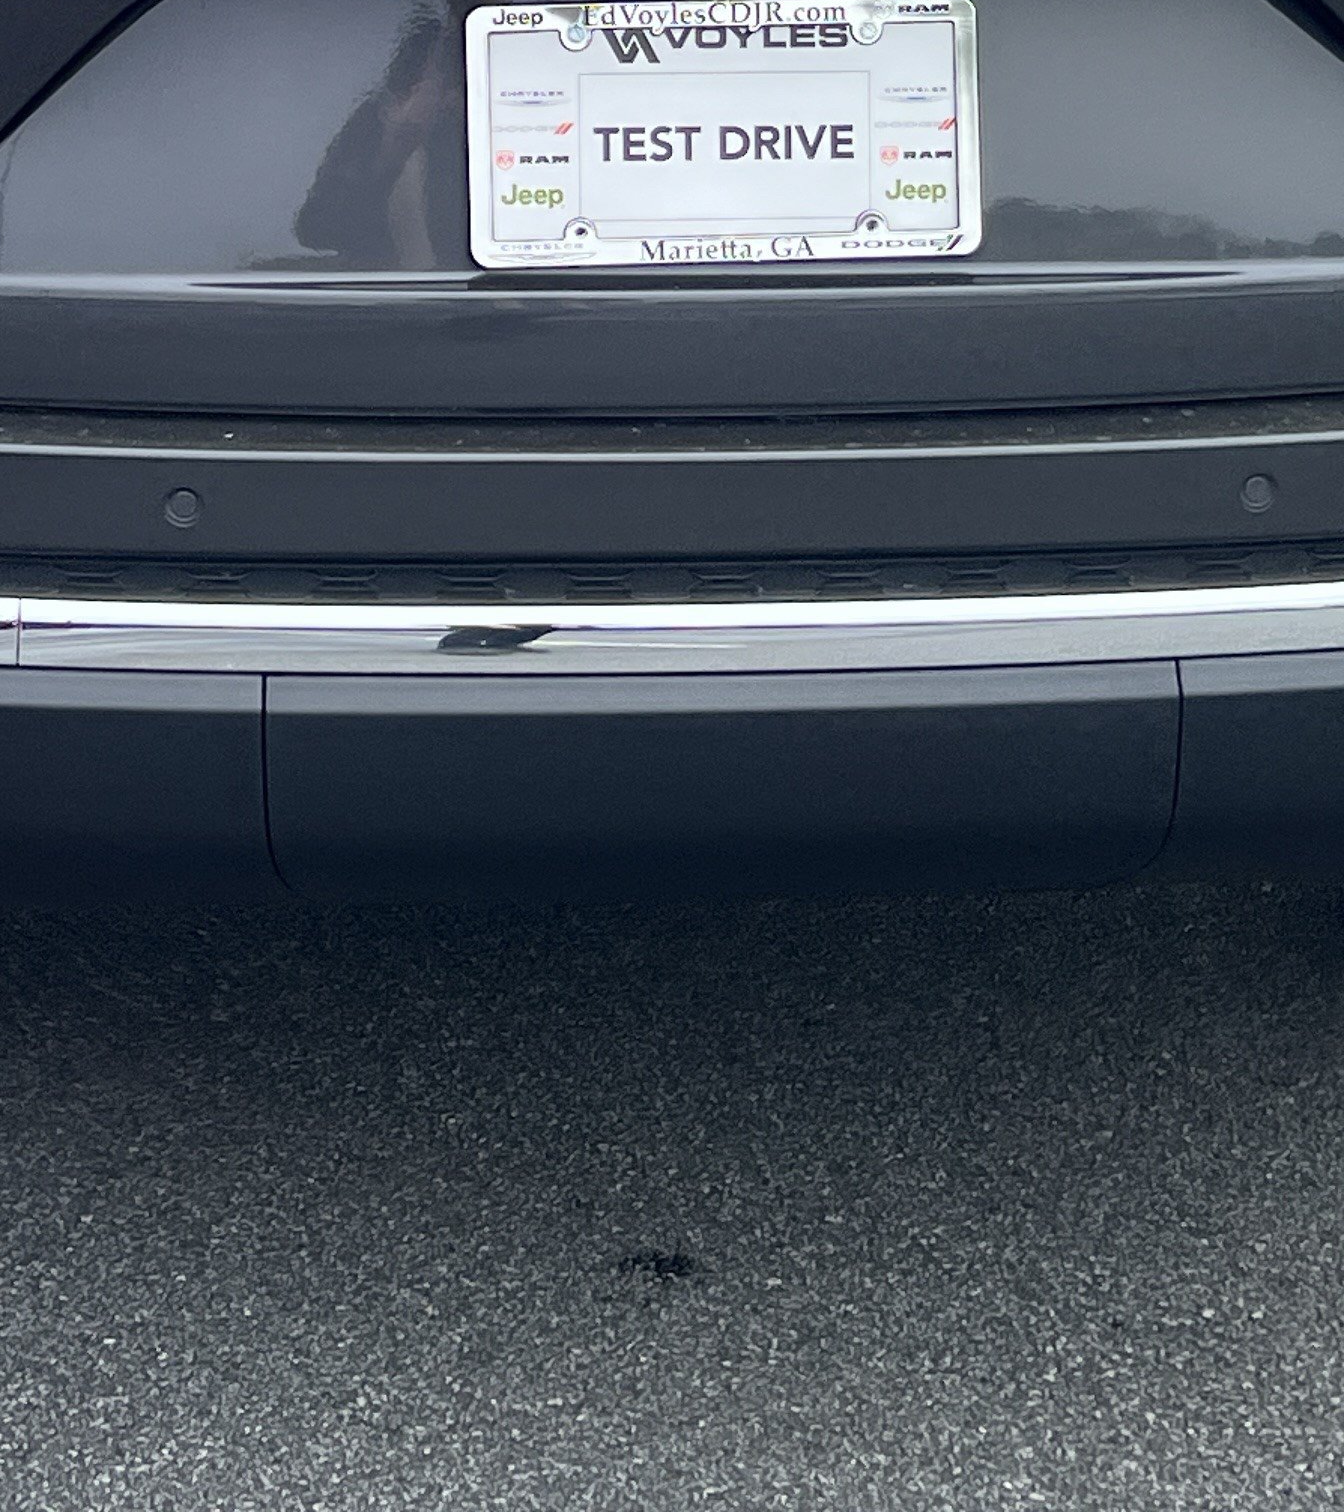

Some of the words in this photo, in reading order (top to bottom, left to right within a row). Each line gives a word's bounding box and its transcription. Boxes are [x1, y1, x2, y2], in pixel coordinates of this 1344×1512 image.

[492, 9, 544, 28] Jeep
[583, 1, 847, 30] EdVoylesCDJR.com
[897, 3, 950, 14] RAM
[664, 25, 849, 49] VOYLES
[593, 125, 702, 162] TEST
[719, 124, 855, 161] DRIVE
[903, 150, 953, 160] RAM
[518, 154, 570, 165] RAM
[500, 183, 565, 209] Jeep
[885, 179, 948, 204] Jeep
[770, 235, 815, 259] GA
